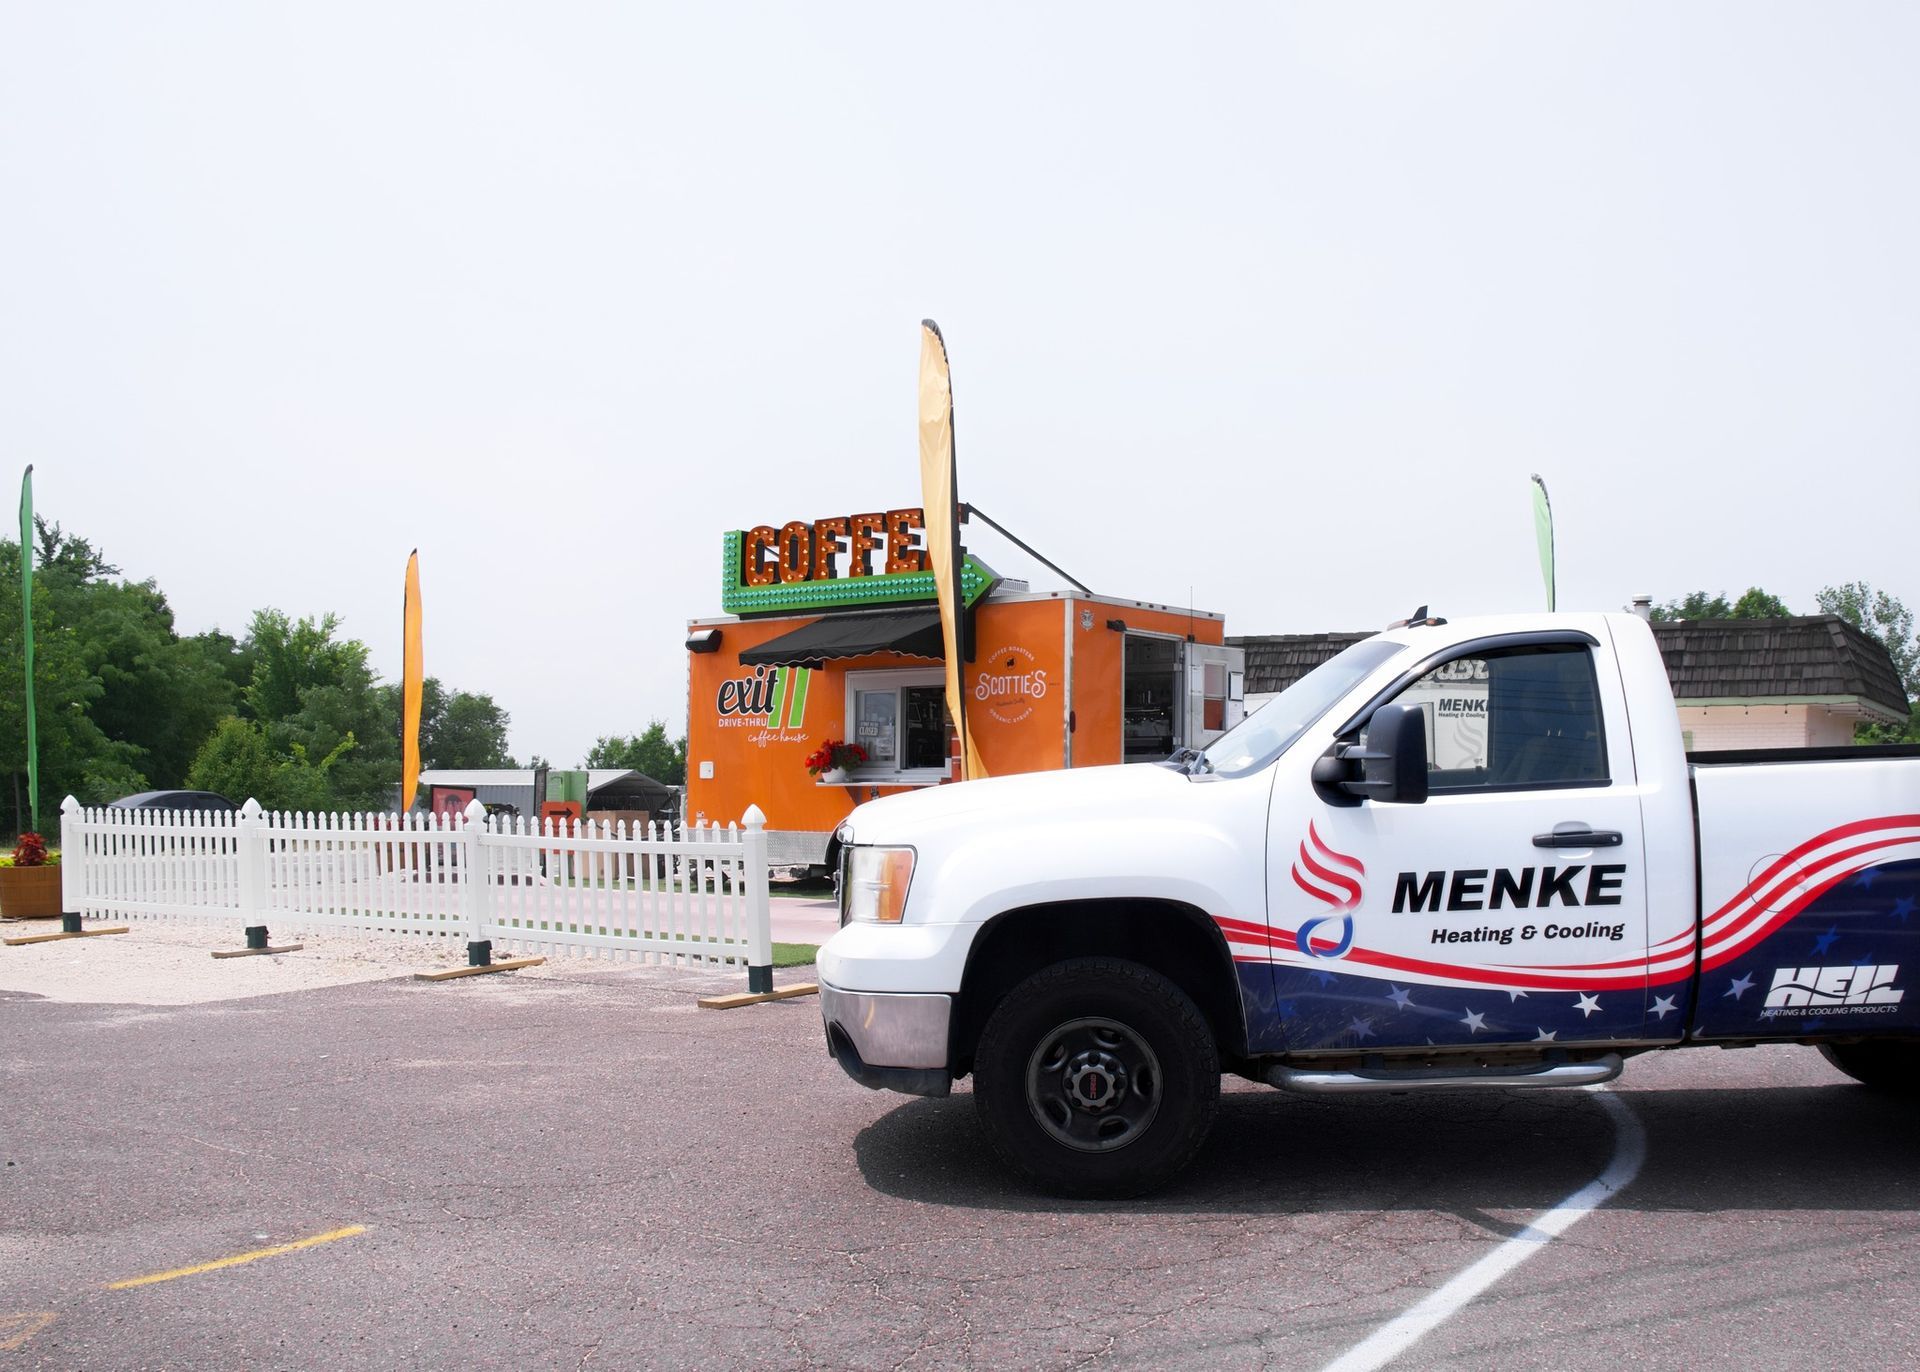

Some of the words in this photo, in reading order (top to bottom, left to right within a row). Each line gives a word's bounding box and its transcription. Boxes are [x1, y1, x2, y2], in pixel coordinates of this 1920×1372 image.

[745, 504, 964, 586] COFFE
[717, 665, 779, 716] exit
[975, 670, 1047, 700] SCOTTIE'S
[718, 718, 767, 728] DRIVE-THRU
[747, 730, 779, 748] coffee
[780, 727, 809, 743] house
[1391, 864, 1627, 914] MENKE
[1431, 926, 1515, 945] Heating
[1520, 924, 1538, 941] &
[1544, 921, 1626, 942] Cooling
[1763, 964, 1905, 1008] HEIL
[1760, 1008, 1799, 1017] HEATING
[1800, 1008, 1806, 1016] &
[1808, 1007, 1848, 1016] COOLING
[1849, 1005, 1898, 1014] PRODUCTS
